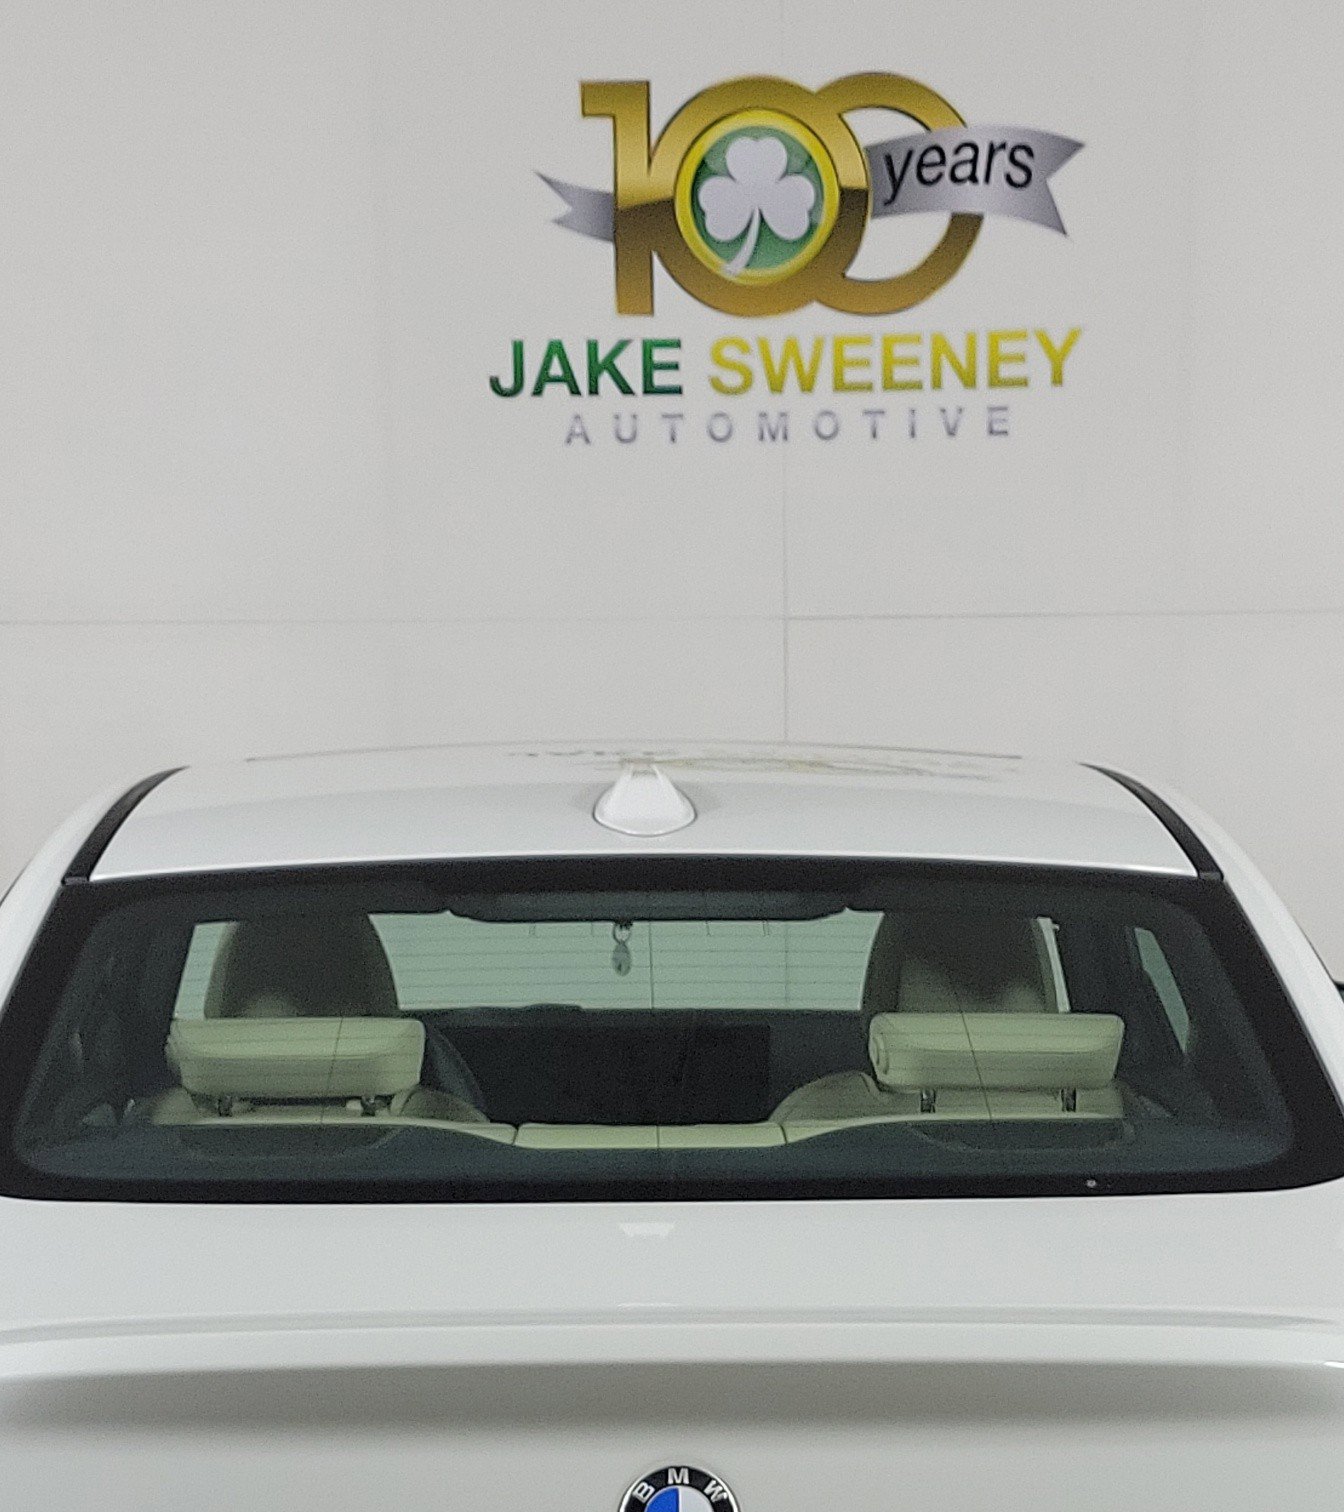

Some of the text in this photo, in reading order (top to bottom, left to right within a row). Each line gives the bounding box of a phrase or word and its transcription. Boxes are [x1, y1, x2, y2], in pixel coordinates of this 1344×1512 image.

[581, 72, 985, 318] 100
[884, 140, 1035, 205] years
[489, 328, 1084, 398] JAKE SWEENEY
[565, 405, 1011, 446] AUTOMOTIVE
[633, 1468, 728, 1504] BMW
